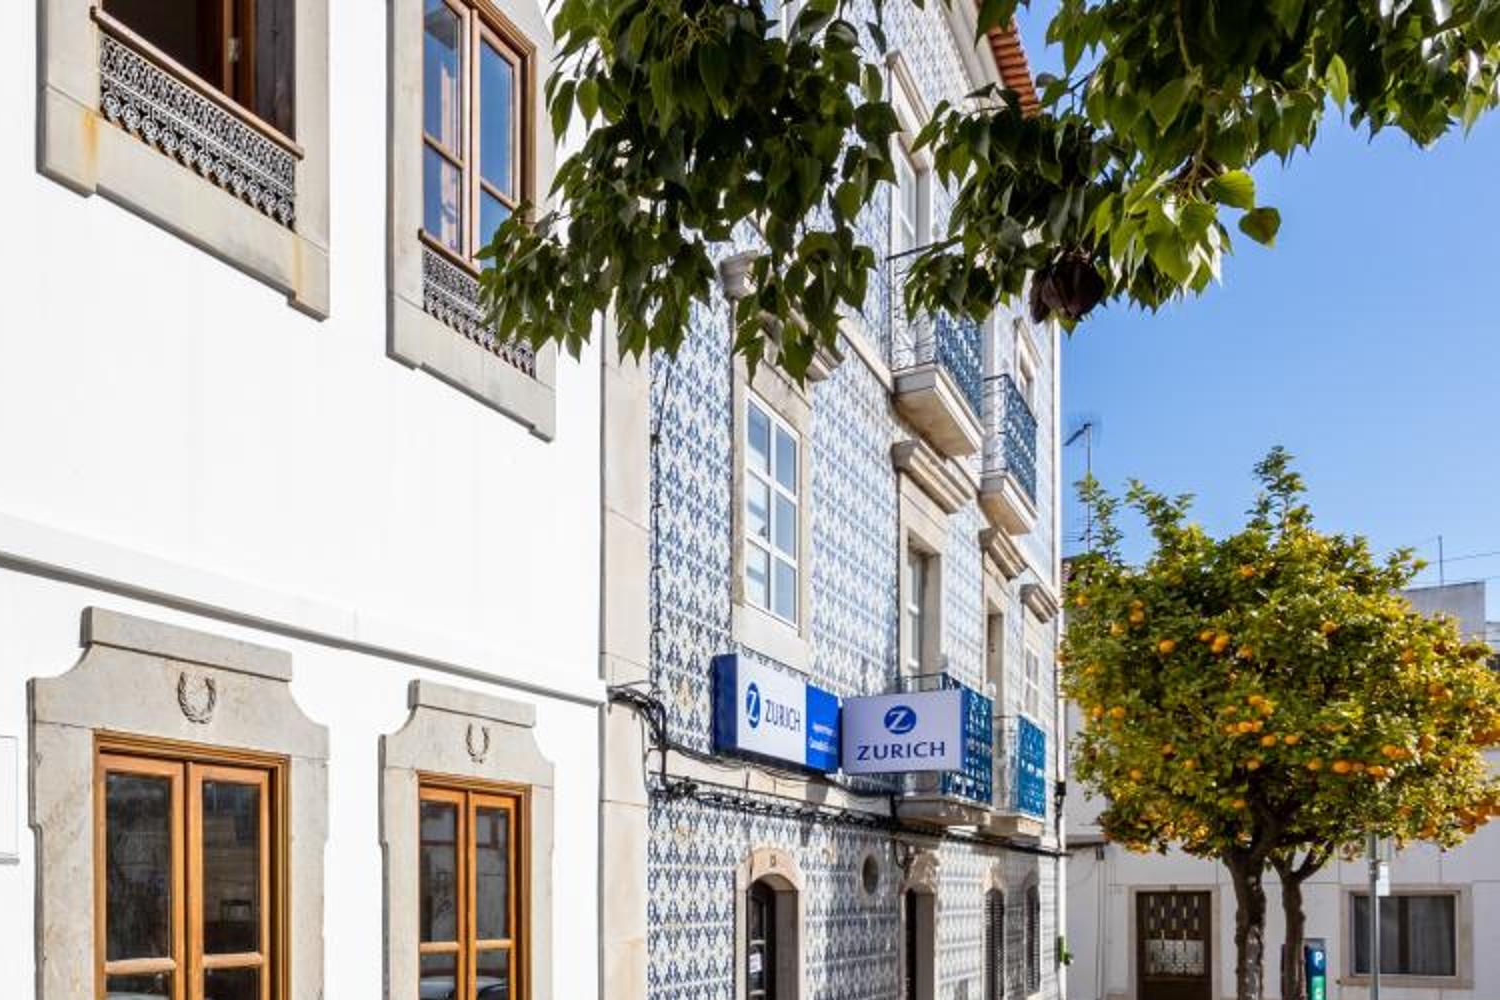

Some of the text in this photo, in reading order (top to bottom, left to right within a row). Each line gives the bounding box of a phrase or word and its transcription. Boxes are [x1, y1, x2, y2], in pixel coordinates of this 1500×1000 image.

[748, 688, 759, 724] Z
[765, 698, 802, 733] ZURICH
[887, 708, 913, 732] Z
[857, 741, 945, 761] ZURICH
[1314, 951, 1323, 968] P
